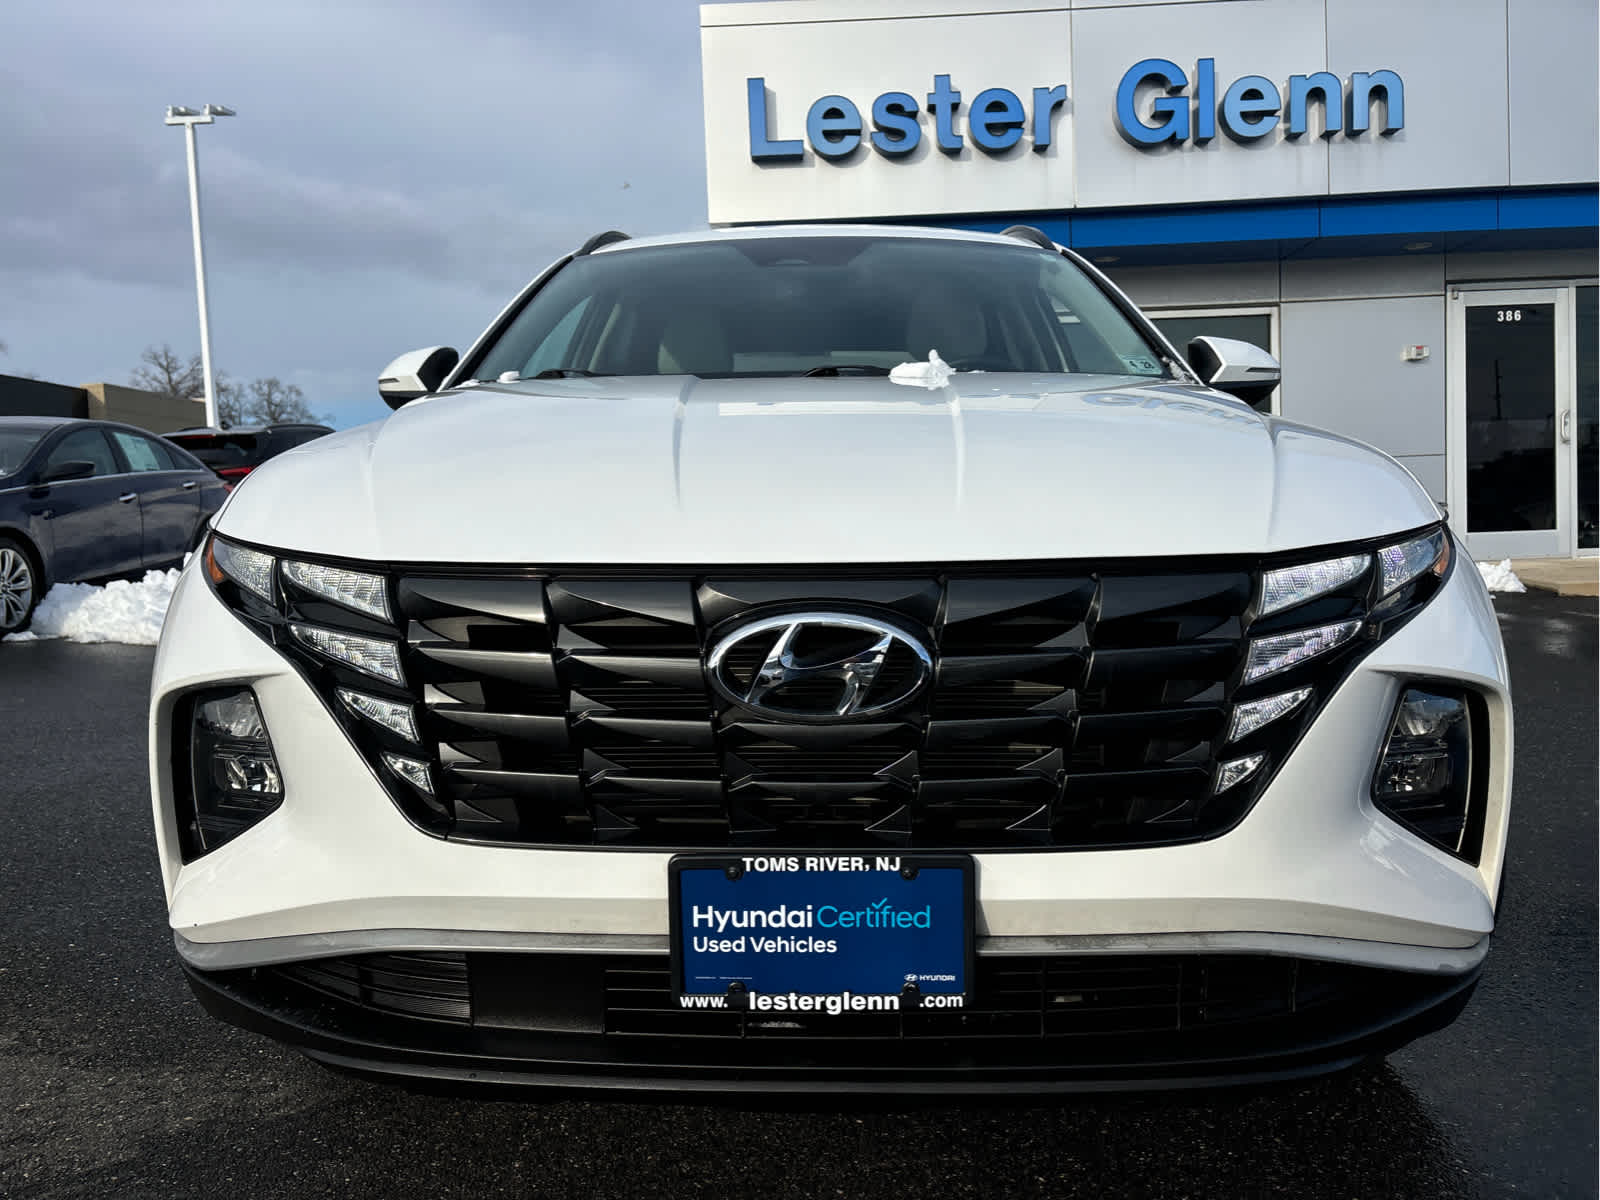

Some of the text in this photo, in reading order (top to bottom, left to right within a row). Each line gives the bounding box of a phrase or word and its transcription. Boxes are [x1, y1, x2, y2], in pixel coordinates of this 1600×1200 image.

[747, 57, 1405, 164] Lester Glenn
[1497, 310, 1522, 322] 386
[742, 857, 902, 873] TOMS RIVER, NJ
[692, 898, 932, 933] Hyundai Certified
[693, 936, 838, 953] Used Vehicles
[680, 992, 964, 1016] www. lesterglenn .com
